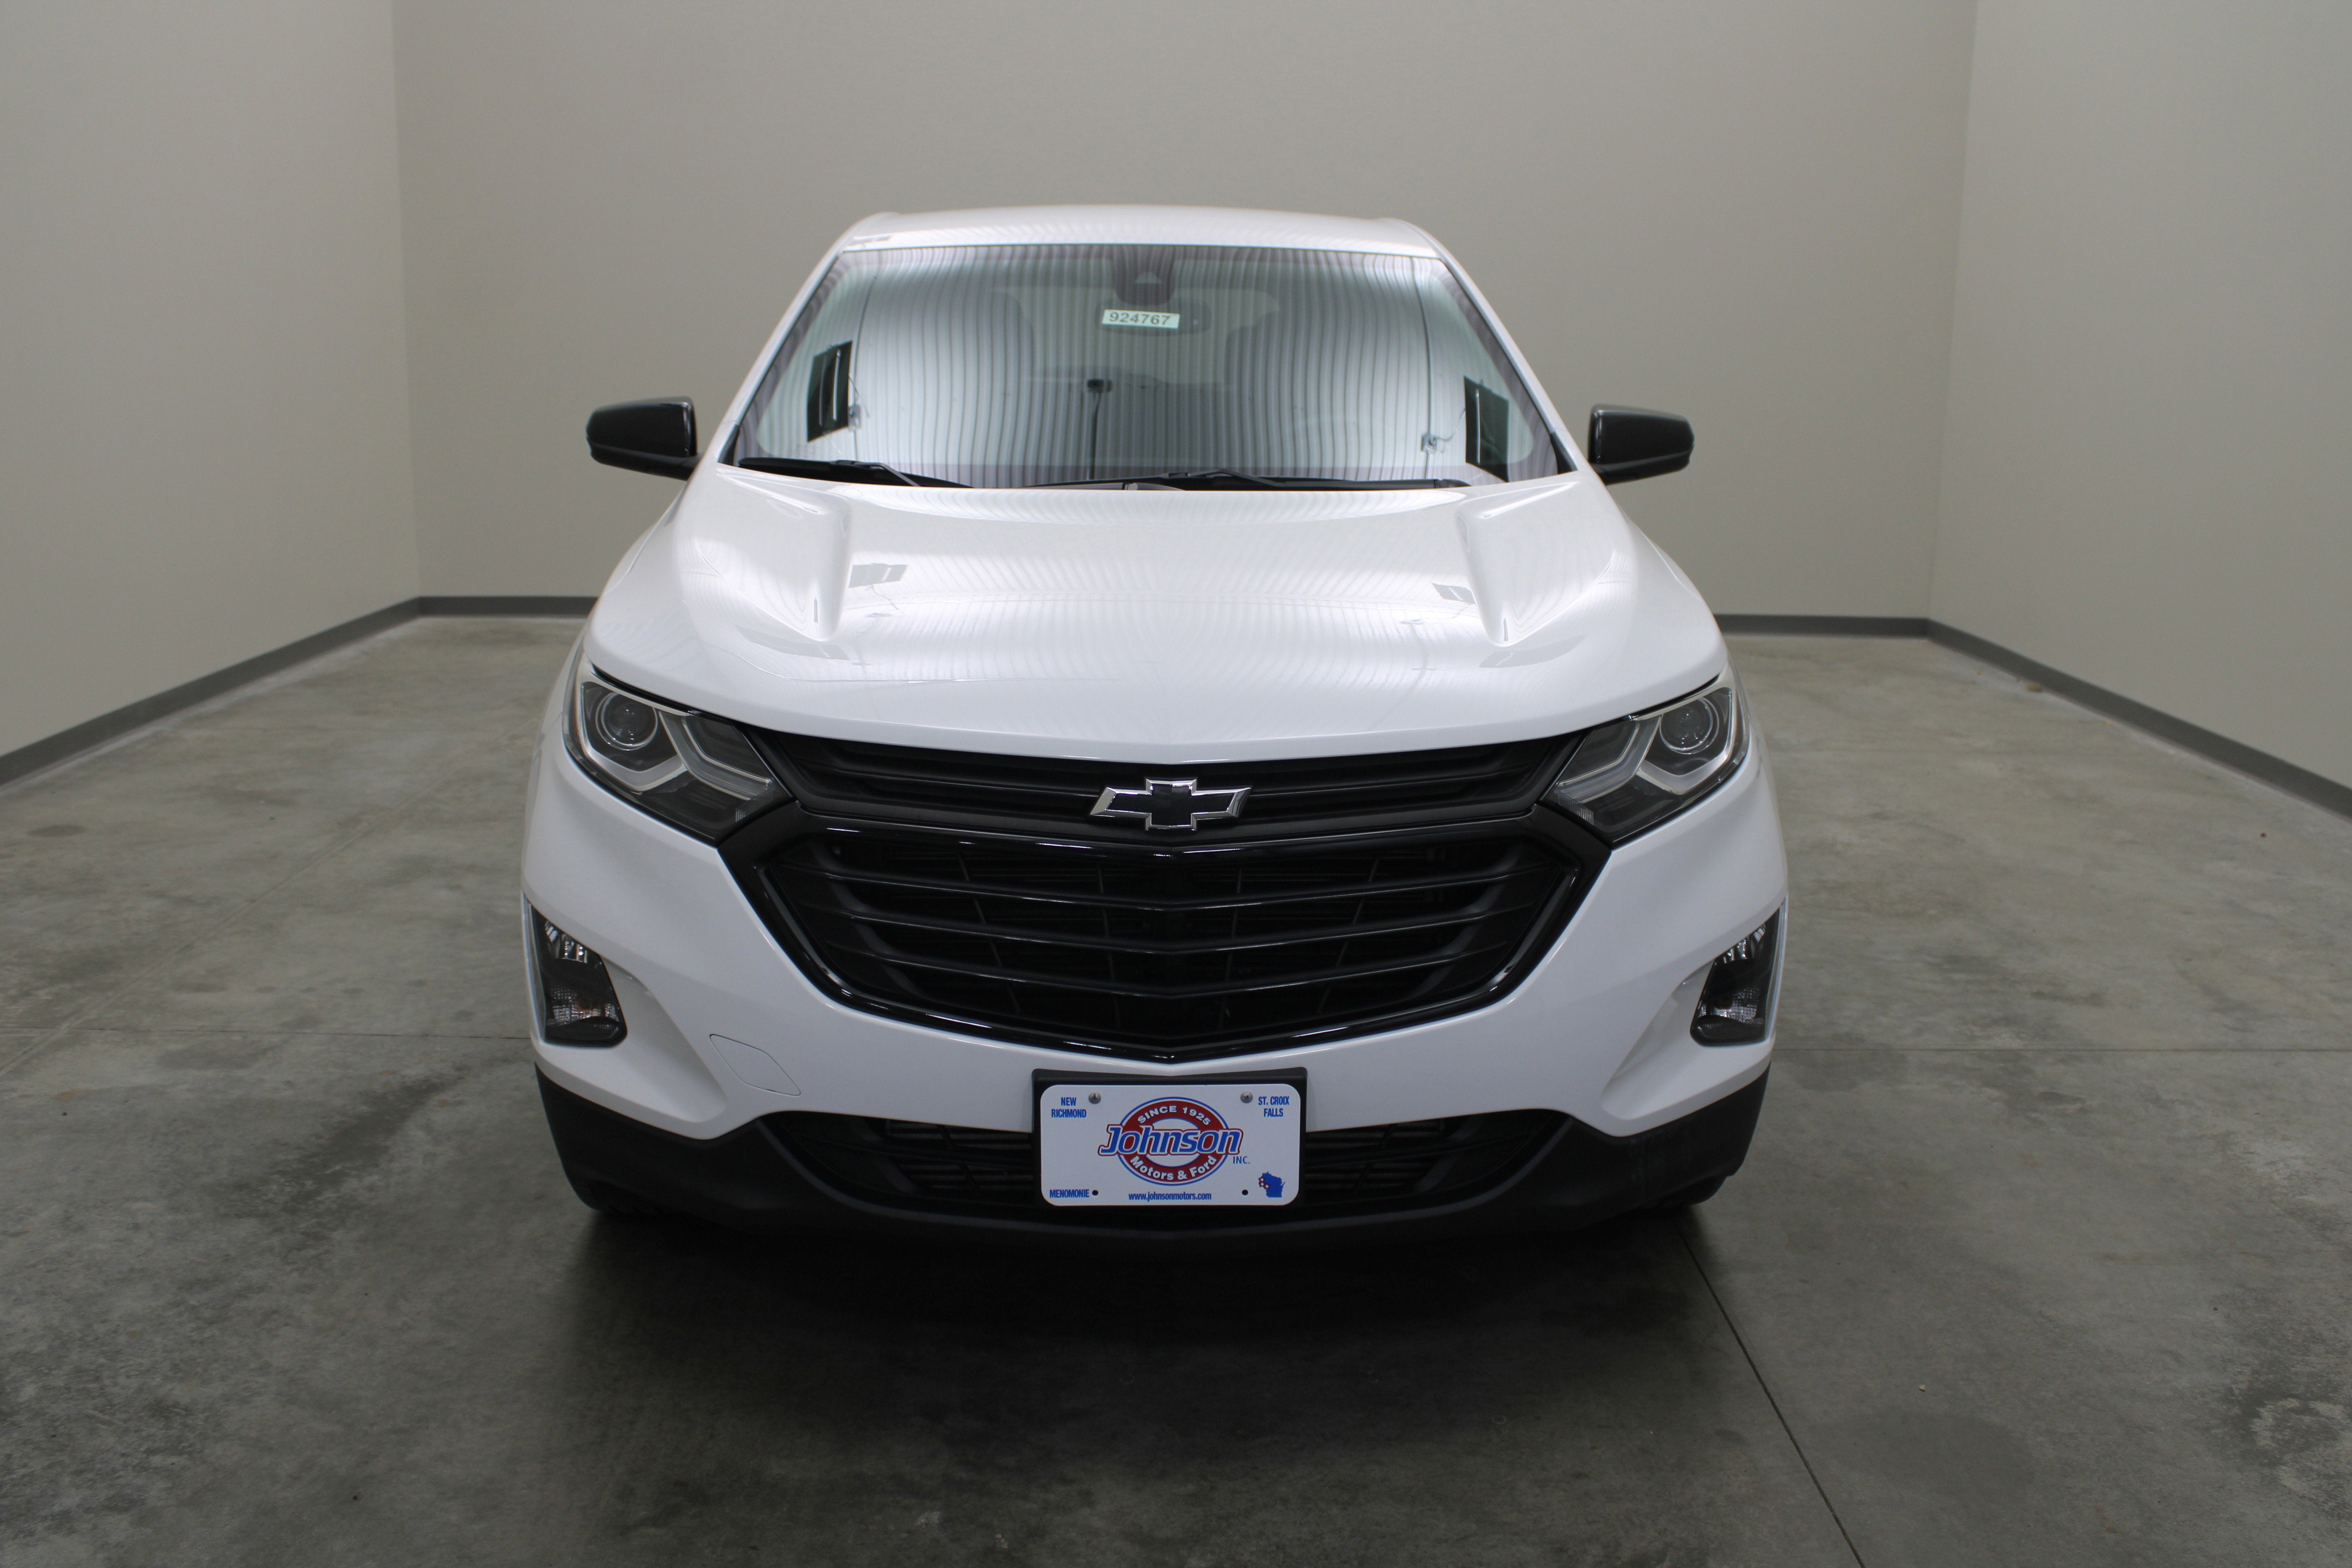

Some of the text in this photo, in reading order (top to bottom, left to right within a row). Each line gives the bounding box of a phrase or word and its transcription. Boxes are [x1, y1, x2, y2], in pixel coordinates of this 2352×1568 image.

[1109, 311, 1170, 325] 924767
[1061, 1097, 1076, 1106] NEW
[1258, 1096, 1290, 1105] ST. CROIX
[1051, 1109, 1086, 1118] RICHMOND
[1138, 1105, 1211, 1125] SINCE 1925
[1264, 1108, 1283, 1117] FALLS
[1098, 1124, 1244, 1156] Johnson
[1233, 1156, 1250, 1164] INC.
[1130, 1155, 1217, 1180] Motors & Ford
[1050, 1189, 1089, 1198] MENOMONIE
[1129, 1192, 1212, 1202] www.johnsonmotors.com
